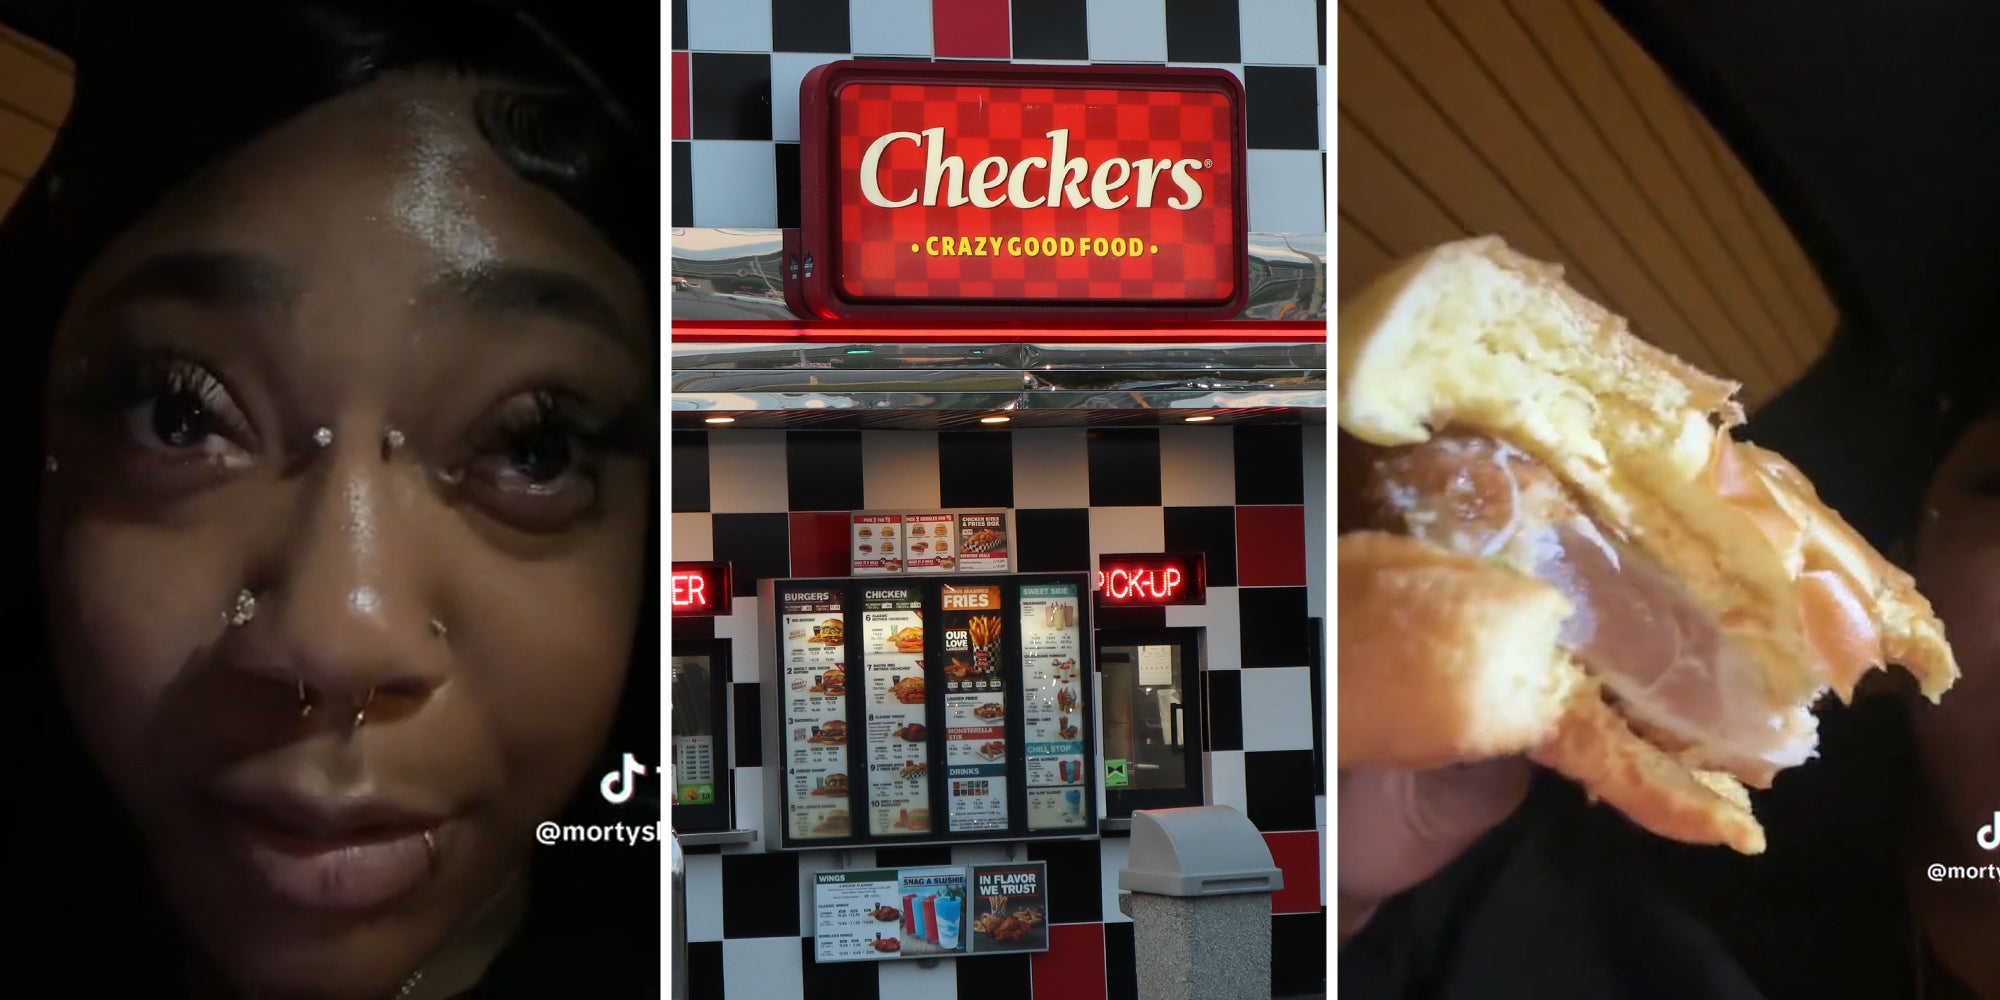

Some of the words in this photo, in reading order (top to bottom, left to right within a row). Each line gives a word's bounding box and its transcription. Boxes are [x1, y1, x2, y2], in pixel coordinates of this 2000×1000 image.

[860, 127, 1203, 210] Checkers
[925, 236, 1003, 257] CRAZY
[1007, 236, 1075, 257] GOOD
[1079, 236, 1145, 257] FOOD
[785, 592, 830, 602] BURGERS
[865, 591, 908, 599] CHICKEN
[944, 594, 990, 608] FRIES
[946, 631, 968, 640] OUR
[950, 768, 980, 776] DRINKS
[980, 876, 991, 884] IN
[994, 874, 1036, 884] FLAVOR
[980, 886, 998, 895] WE
[1001, 884, 1037, 894] TRUST
